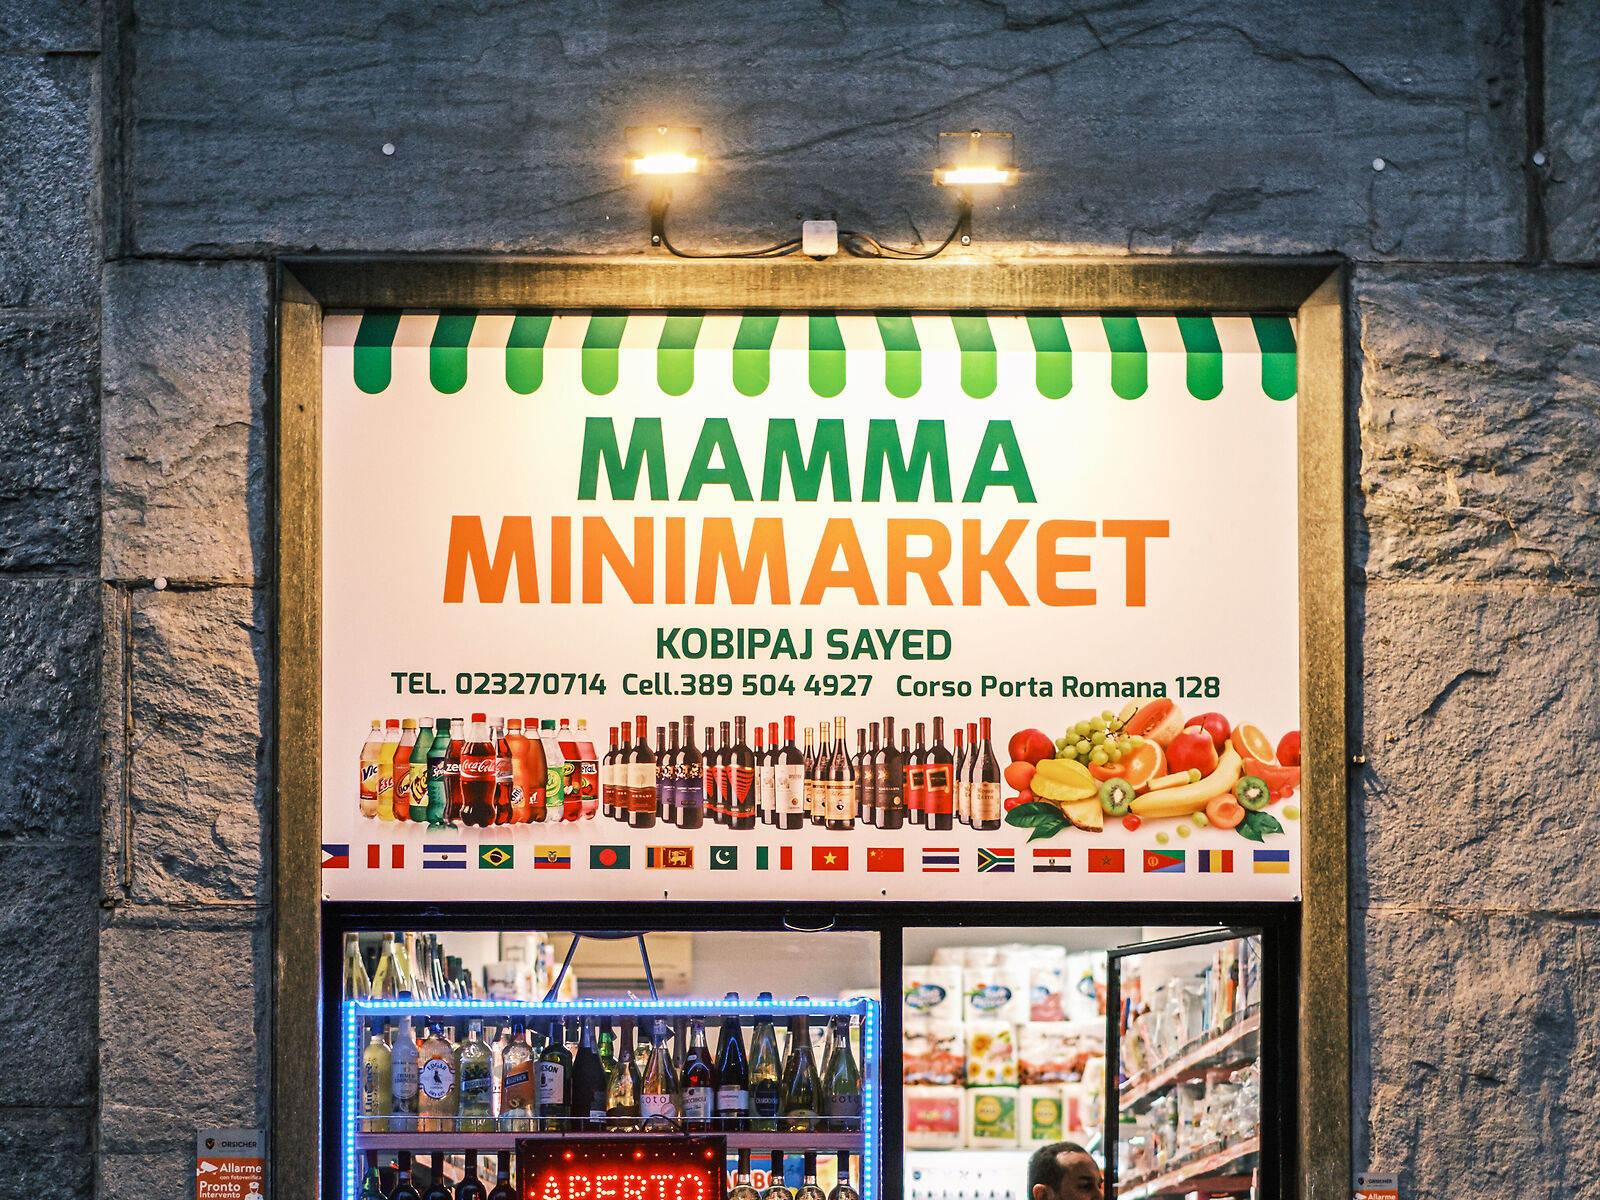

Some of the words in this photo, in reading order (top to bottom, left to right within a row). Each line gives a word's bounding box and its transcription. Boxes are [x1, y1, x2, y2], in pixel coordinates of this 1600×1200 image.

[578, 416, 1038, 504] MAMMA
[442, 514, 1170, 608] MINIMARKET
[656, 627, 813, 661] KOBIPAJ
[827, 628, 952, 661] SAYED
[390, 671, 446, 695] TEL.
[455, 672, 607, 696] 023270714
[742, 673, 796, 696] 504
[803, 674, 873, 697] 4927
[896, 674, 972, 698] Corso
[981, 675, 1053, 698] Porta
[1062, 675, 1167, 698] Romana
[1175, 676, 1220, 698] 128
[462, 759, 496, 773] Coca-Cola
[540, 1064, 559, 1074] ESON
[219, 1162, 262, 1173] Allarme
[200, 1180, 241, 1192] Pronto
[199, 1191, 241, 1199] Intervento
